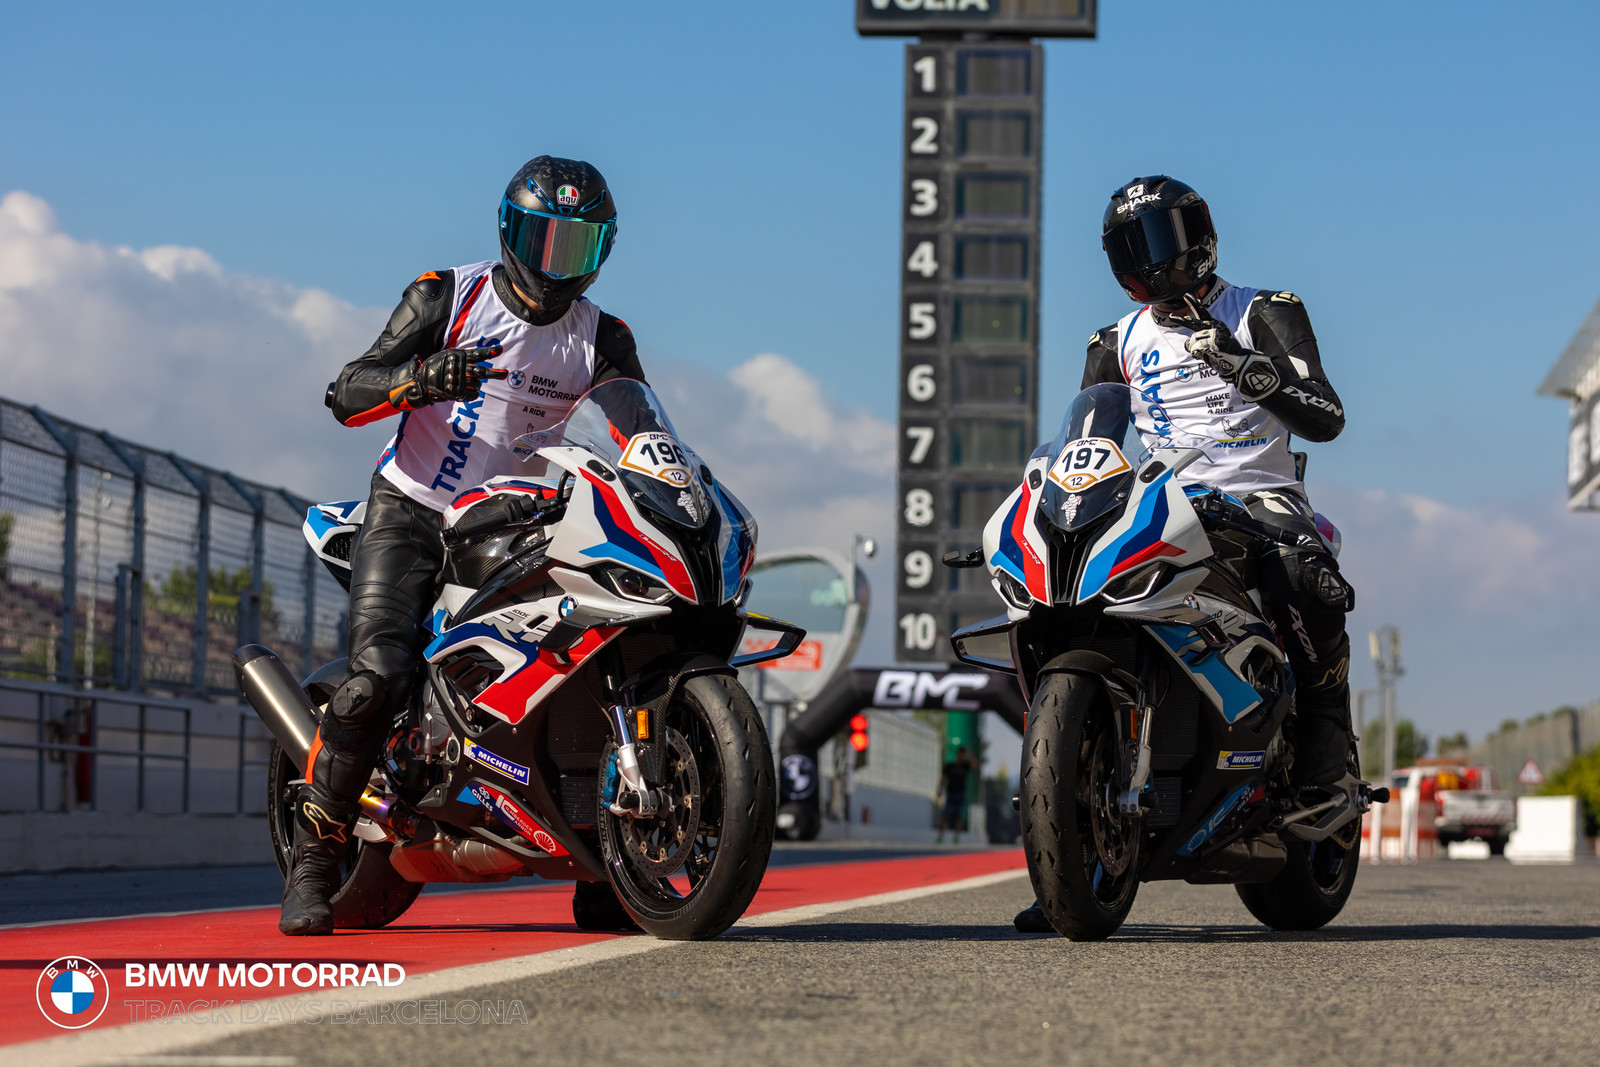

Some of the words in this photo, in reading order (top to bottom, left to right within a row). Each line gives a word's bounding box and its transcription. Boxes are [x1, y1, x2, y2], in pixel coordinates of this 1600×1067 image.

[913, 56, 937, 92] 1
[910, 117, 939, 153] 2
[909, 179, 938, 216] 3
[1117, 192, 1161, 214] SHARK
[907, 241, 938, 278] 4
[909, 302, 937, 339] 5
[531, 375, 558, 388] BMW
[907, 363, 936, 402] 6
[1205, 392, 1231, 403] MAKE
[1214, 406, 1234, 414] RIDE
[1281, 386, 1343, 417] IXON
[529, 407, 546, 418] RIDE
[640, 442, 689, 468] 196
[906, 427, 935, 464] 7
[1076, 439, 1099, 447] BMC
[1213, 437, 1268, 448] MICHELIN
[1061, 447, 1111, 474] 197
[670, 471, 683, 481] 12
[1070, 476, 1083, 486] 12
[905, 488, 935, 526] 8
[904, 550, 934, 588] 9
[900, 612, 937, 650] 10
[872, 670, 990, 709] BMC
[477, 750, 526, 778] MICHELIN
[1231, 755, 1262, 763] MICHELIN
[471, 788, 494, 812] GILLES
